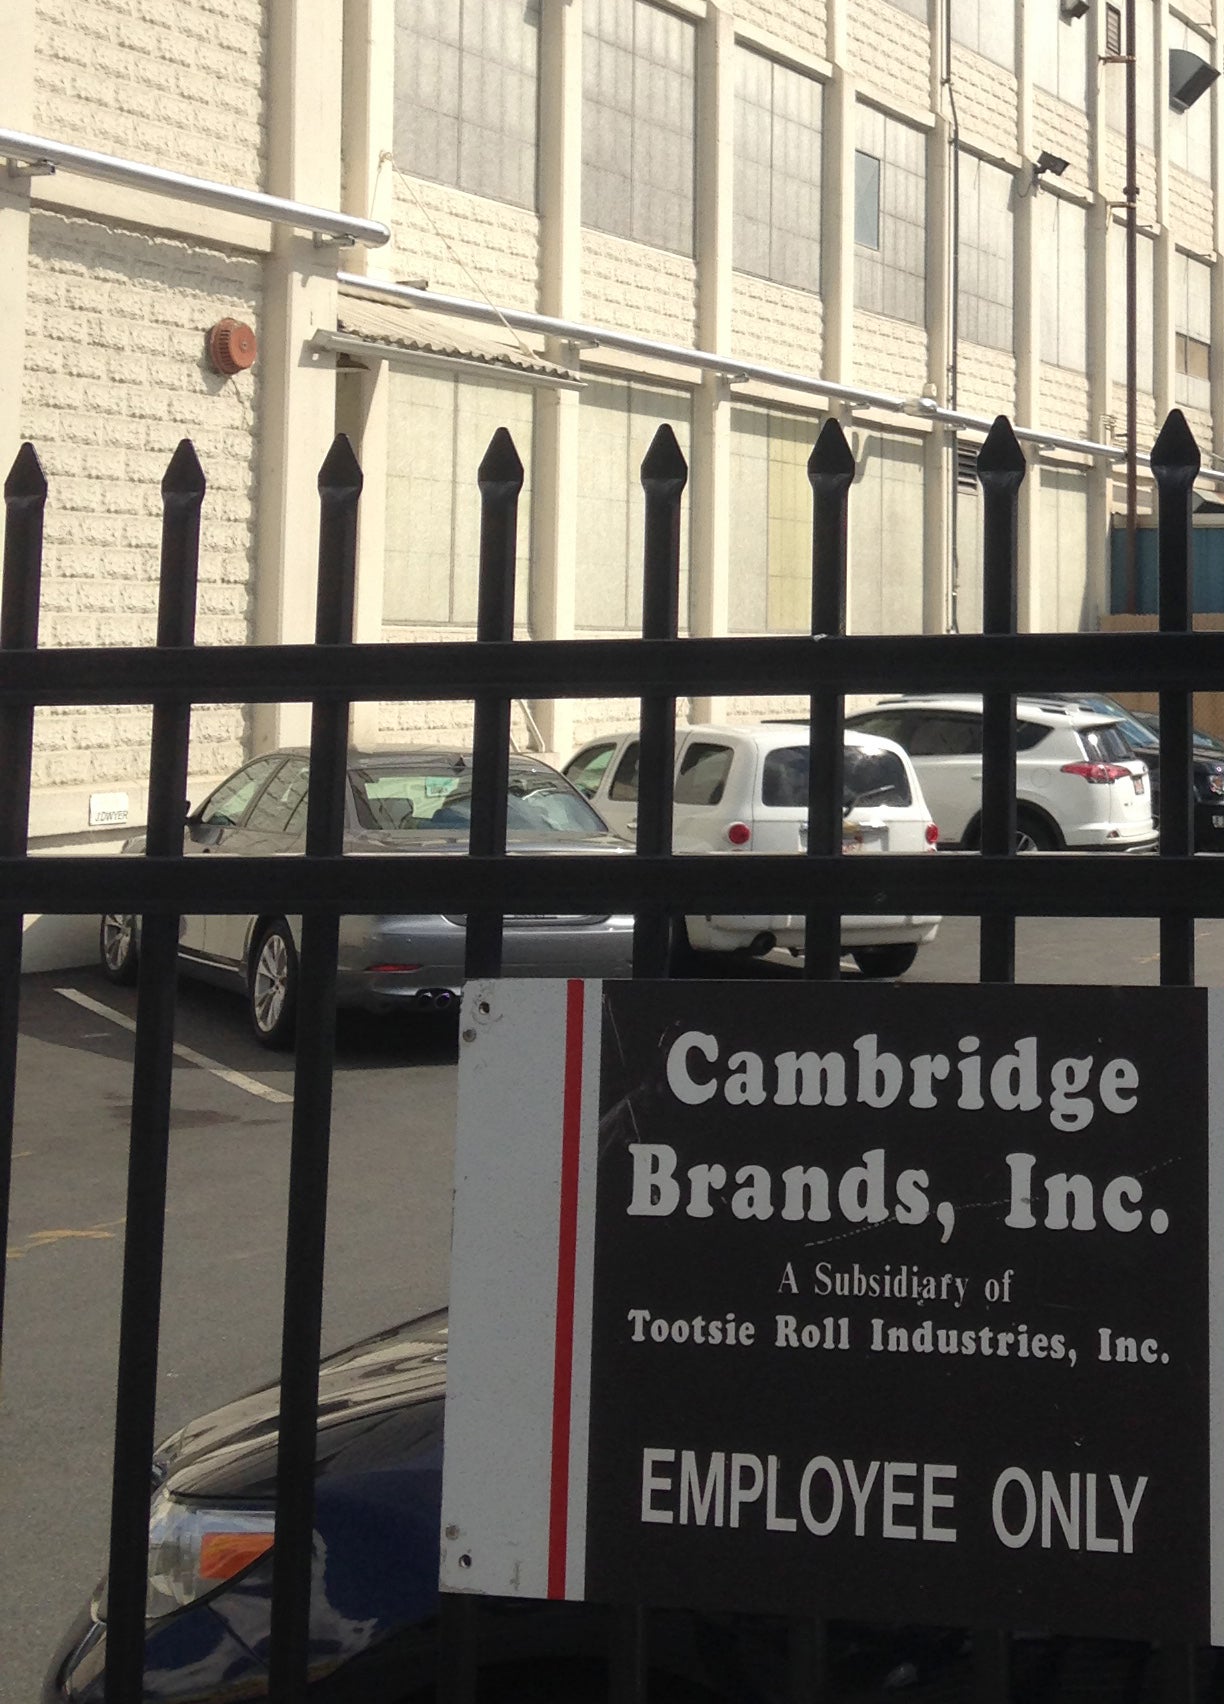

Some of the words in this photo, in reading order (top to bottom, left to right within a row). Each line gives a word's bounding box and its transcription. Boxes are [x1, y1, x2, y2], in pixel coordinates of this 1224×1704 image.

[667, 1031, 1140, 1132] Cambridge
[627, 1144, 955, 1243] Brands,
[1005, 1153, 1169, 1234] Inc.
[778, 1263, 799, 1294] A
[815, 1263, 968, 1307] Subsidiary
[985, 1270, 1014, 1302] of
[628, 1309, 755, 1346] Tootsie
[775, 1315, 850, 1350] Roll
[871, 1319, 1077, 1367] Industries,
[1099, 1328, 1170, 1364] Inc.
[642, 1448, 957, 1541] EMPLOYEE
[993, 1467, 1149, 1554] ONLY
